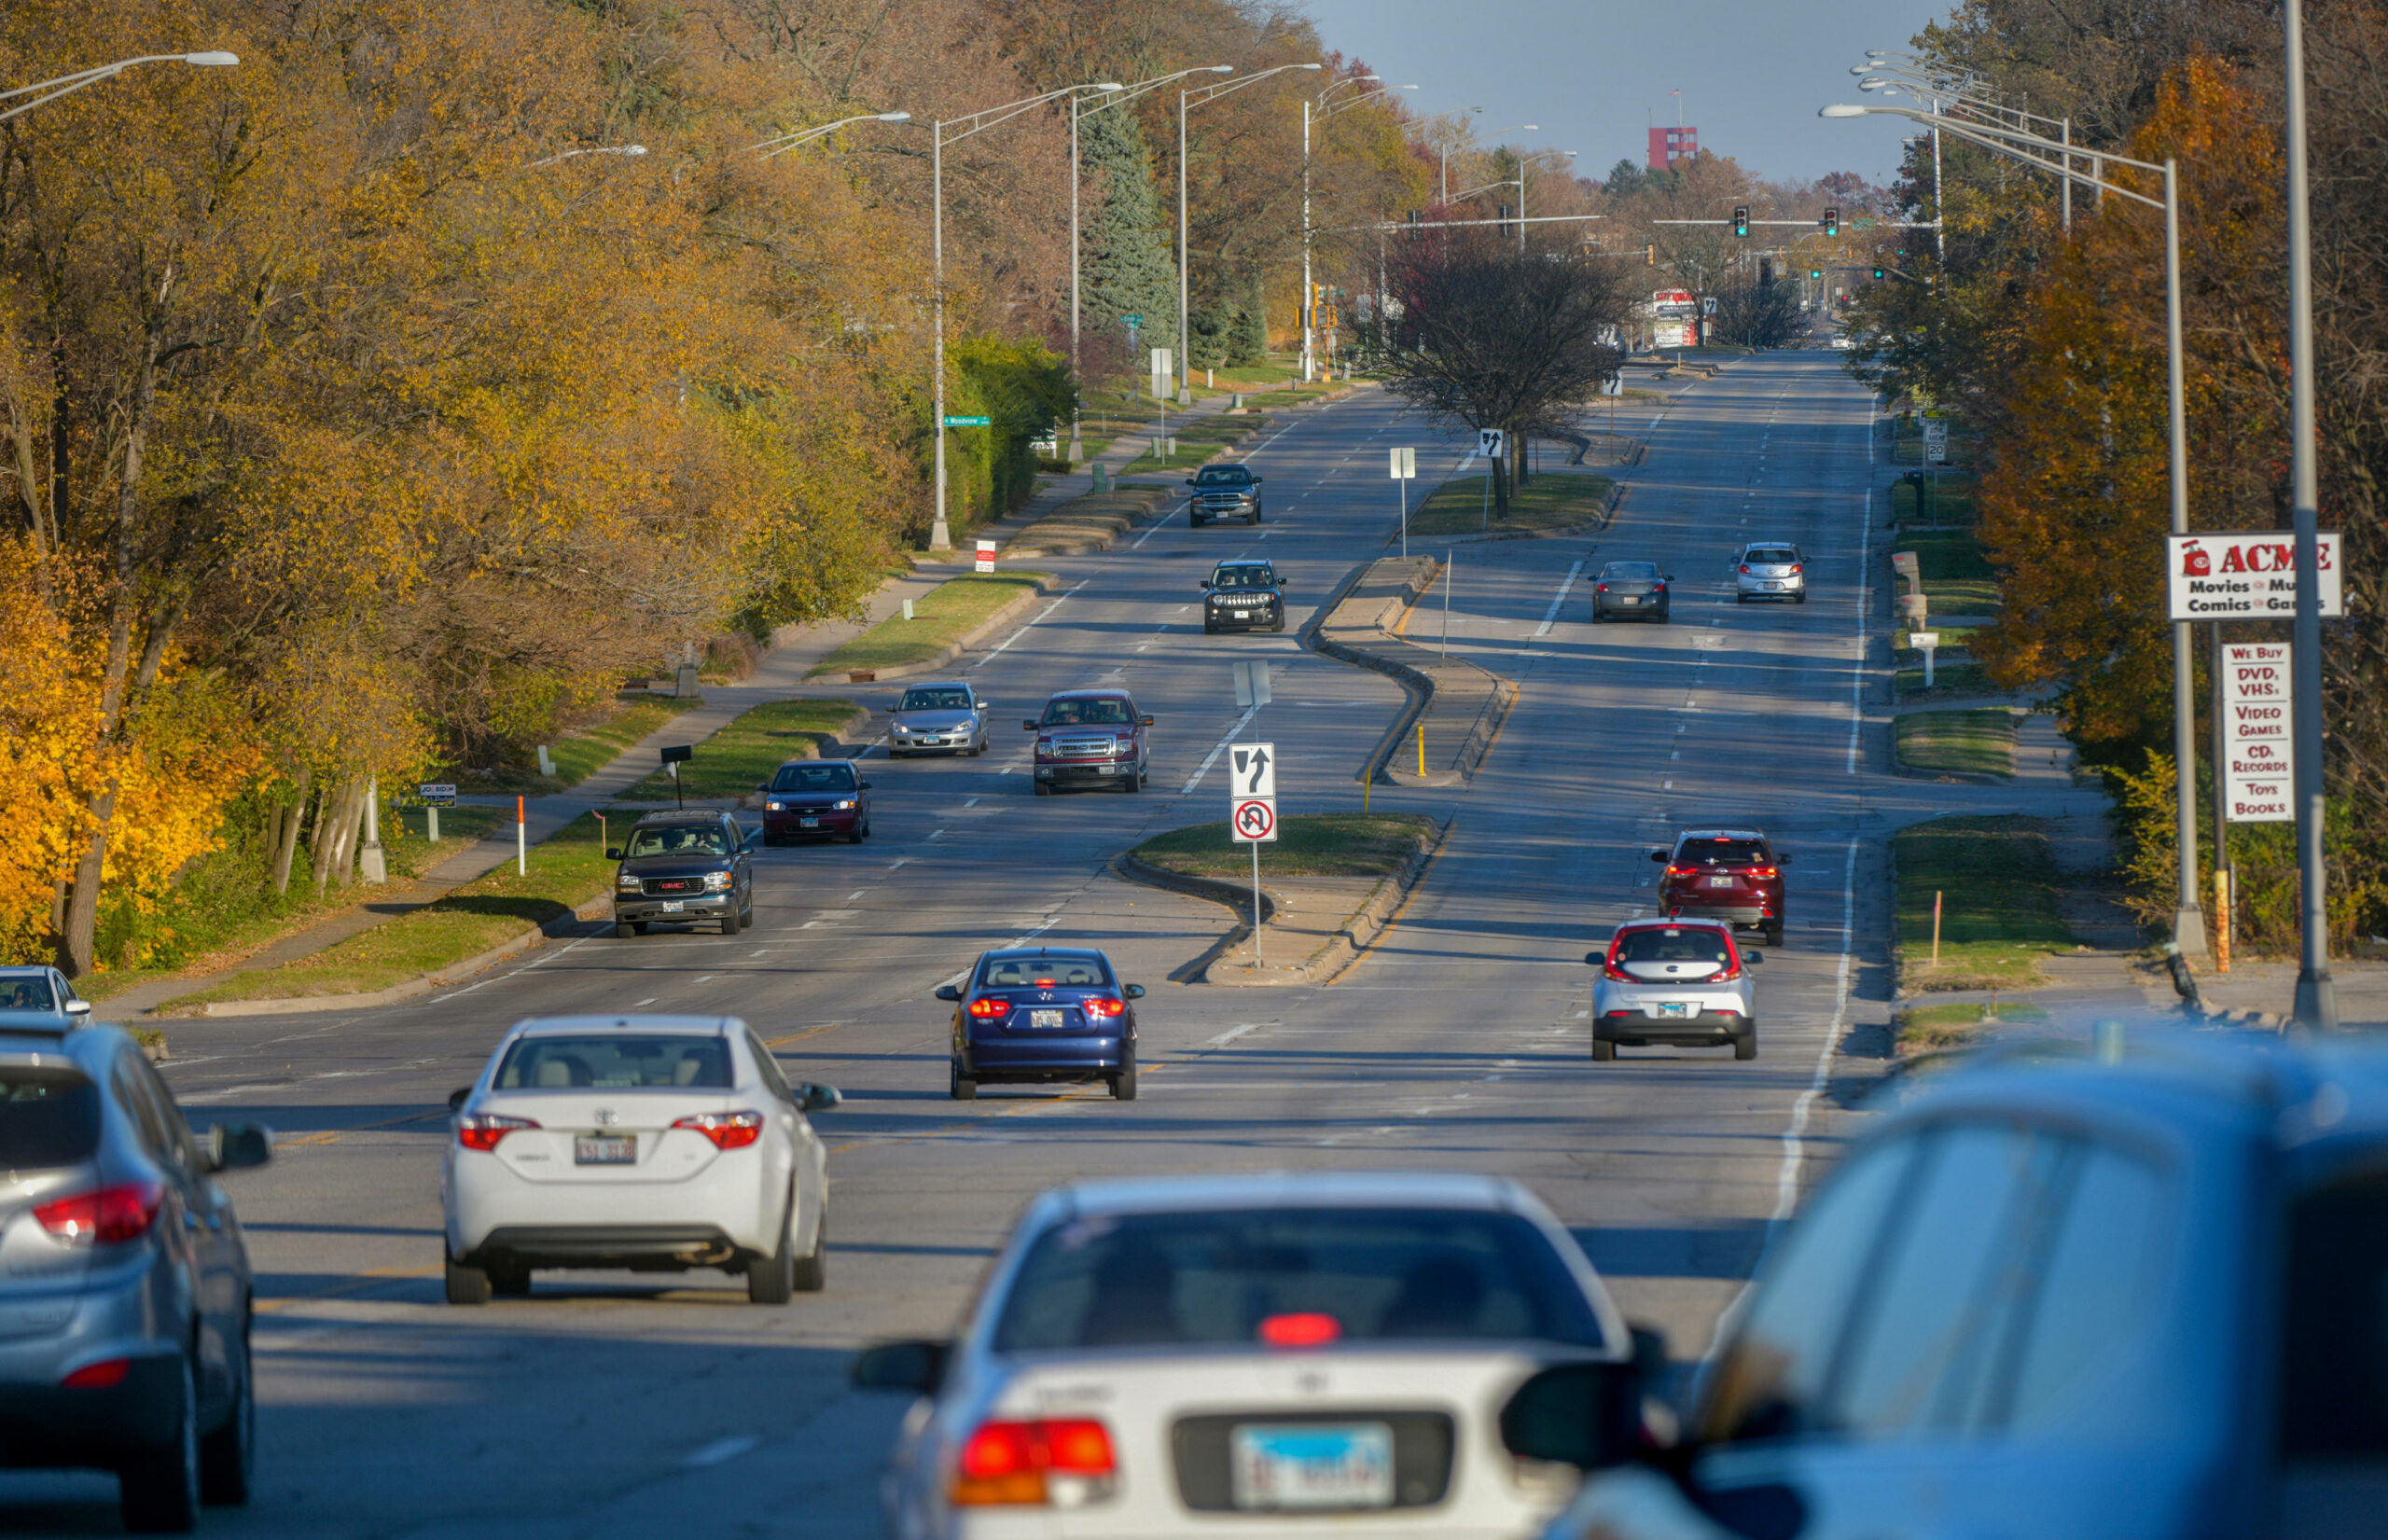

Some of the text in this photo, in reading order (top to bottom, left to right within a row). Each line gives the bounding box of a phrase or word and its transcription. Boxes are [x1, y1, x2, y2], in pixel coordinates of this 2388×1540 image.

[1929, 445, 1943, 454] 20
[2189, 579, 2250, 593] Movies
[2188, 598, 2325, 612] Comics Gas
